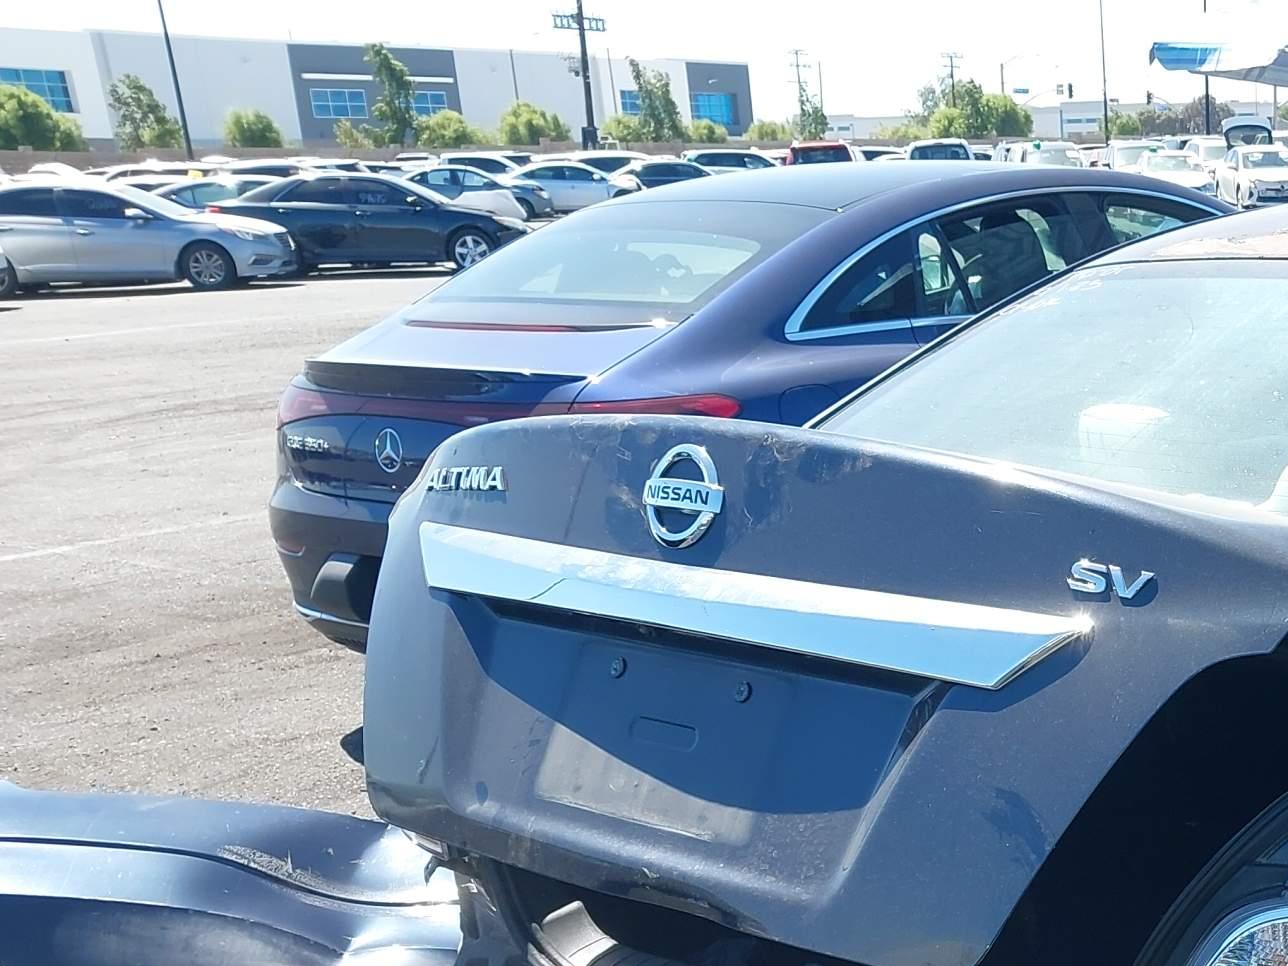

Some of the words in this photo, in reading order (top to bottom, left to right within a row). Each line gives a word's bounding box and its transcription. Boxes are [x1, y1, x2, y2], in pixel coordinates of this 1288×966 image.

[424, 466, 505, 491] ALTIMA
[647, 484, 710, 506] NISSAN
[1066, 558, 1156, 599] SV
